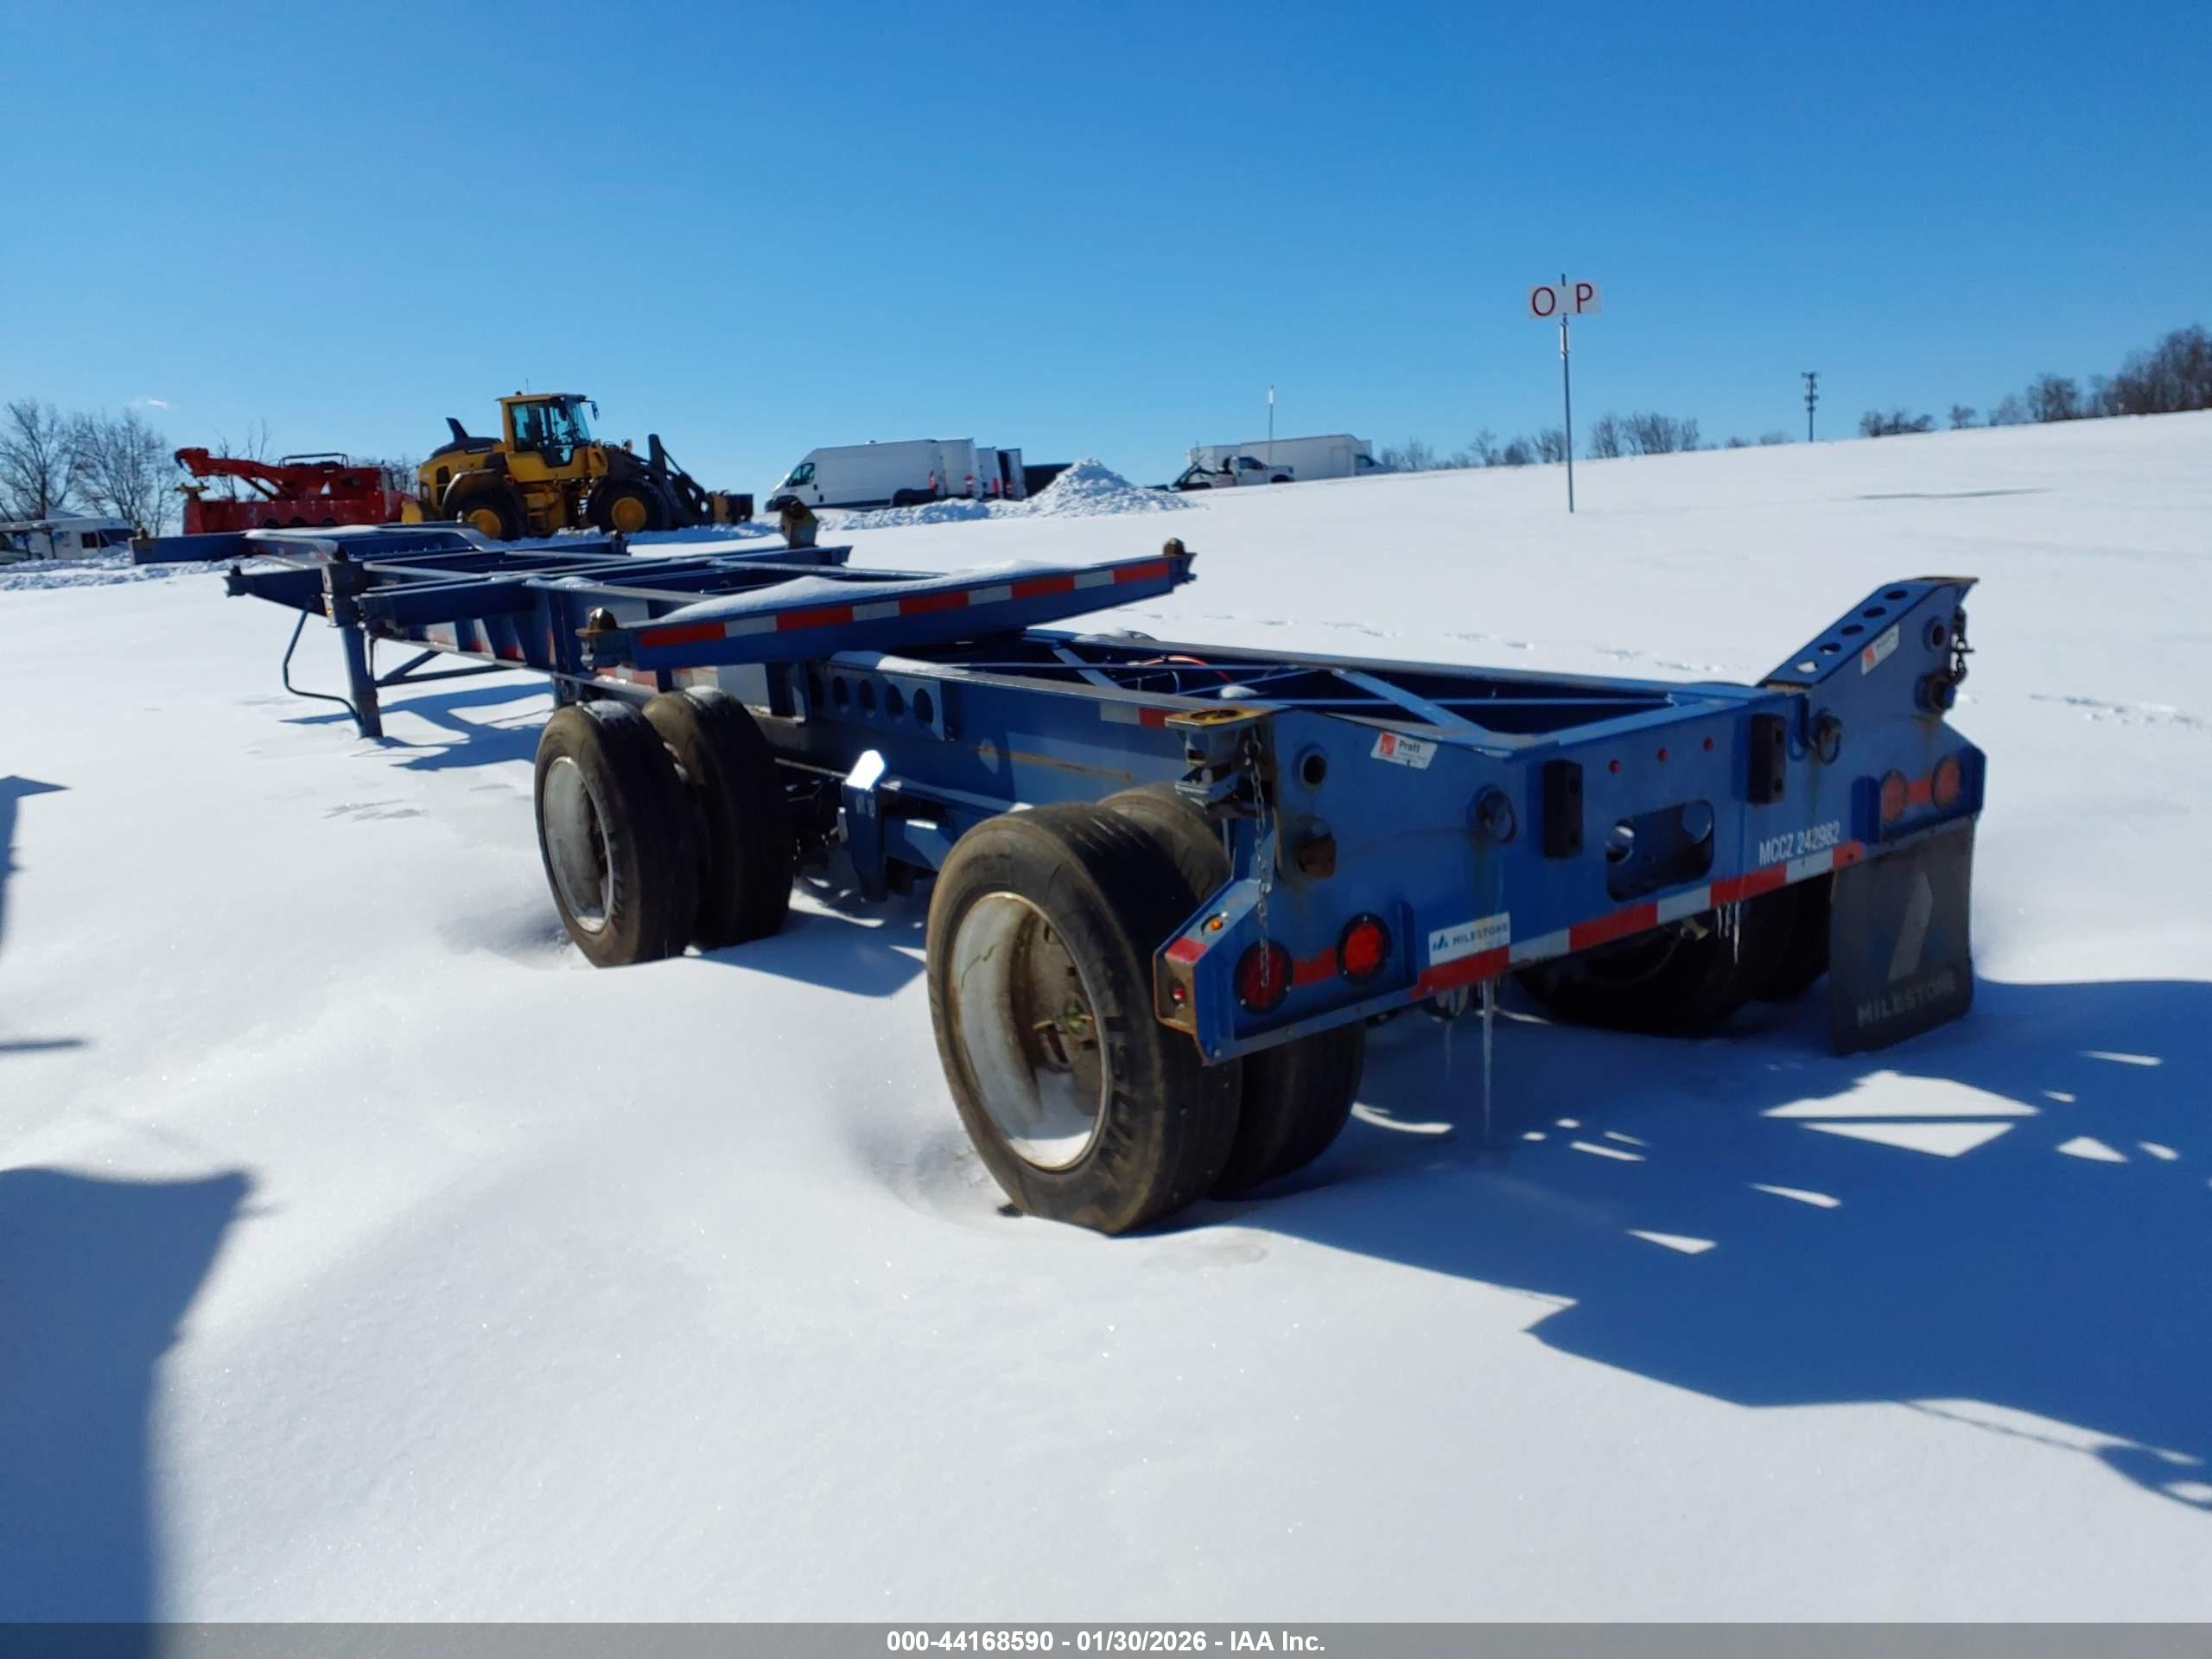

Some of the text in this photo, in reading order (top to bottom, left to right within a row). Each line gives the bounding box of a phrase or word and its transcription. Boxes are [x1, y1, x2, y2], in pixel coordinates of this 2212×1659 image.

[1532, 283, 1593, 317] O P
[1759, 820, 1840, 867] MCCZ 242982
[1452, 922, 1508, 946] MILESTONE
